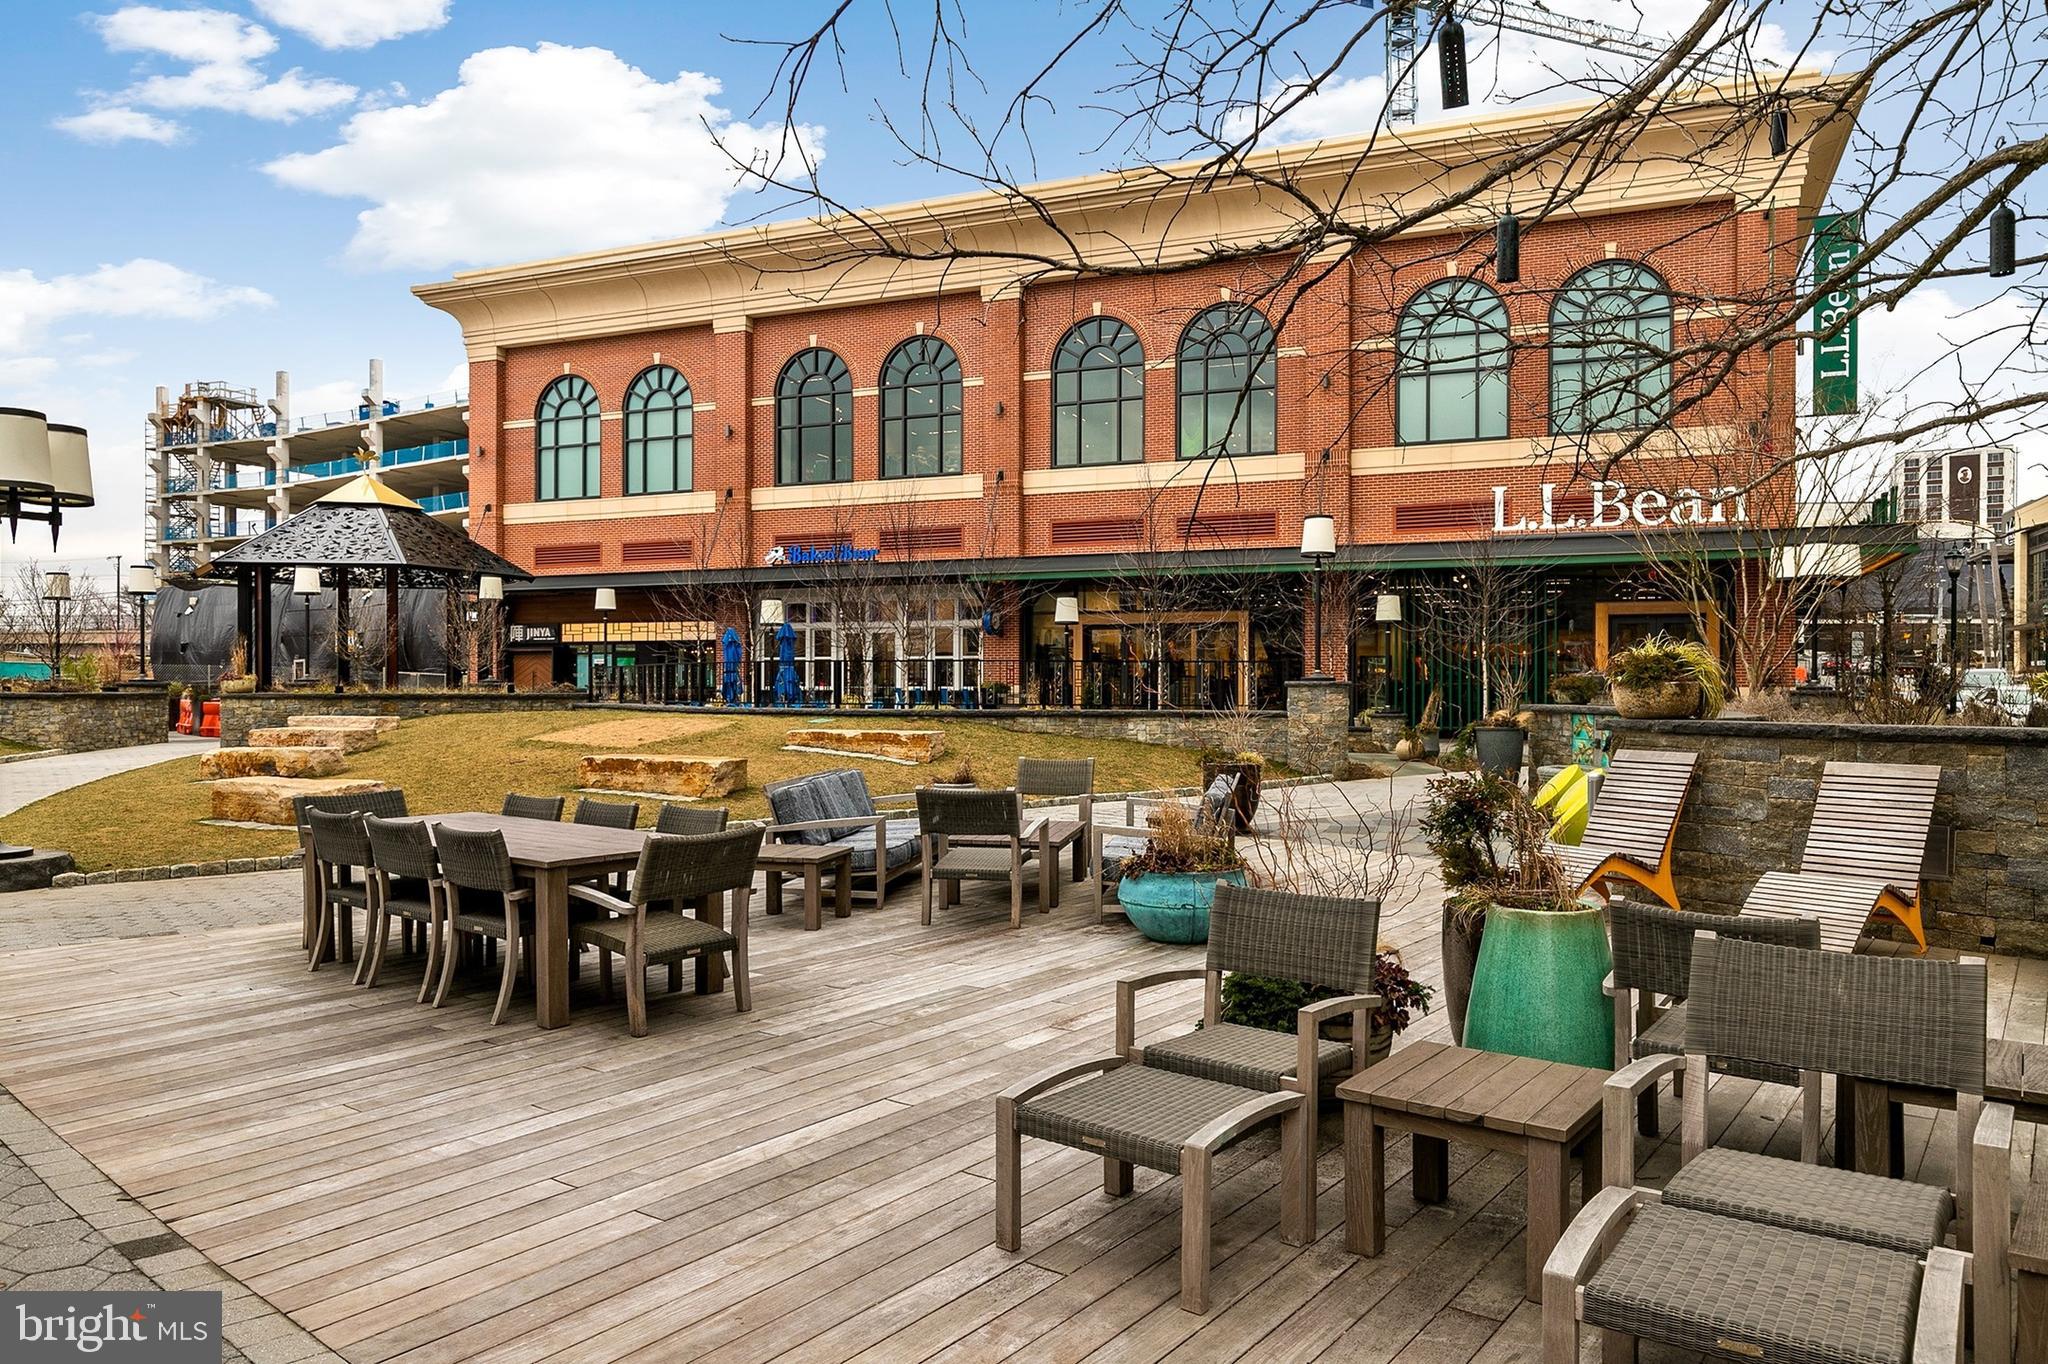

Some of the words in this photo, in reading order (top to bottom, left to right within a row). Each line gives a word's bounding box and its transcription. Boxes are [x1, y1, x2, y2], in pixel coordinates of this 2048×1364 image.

[1820, 248, 1850, 381] L.L.Ben
[1491, 480, 1747, 531] L.L.Bean
[788, 545, 836, 564] Baked
[840, 544, 879, 561] Bear
[526, 628, 551, 640] JINYA
